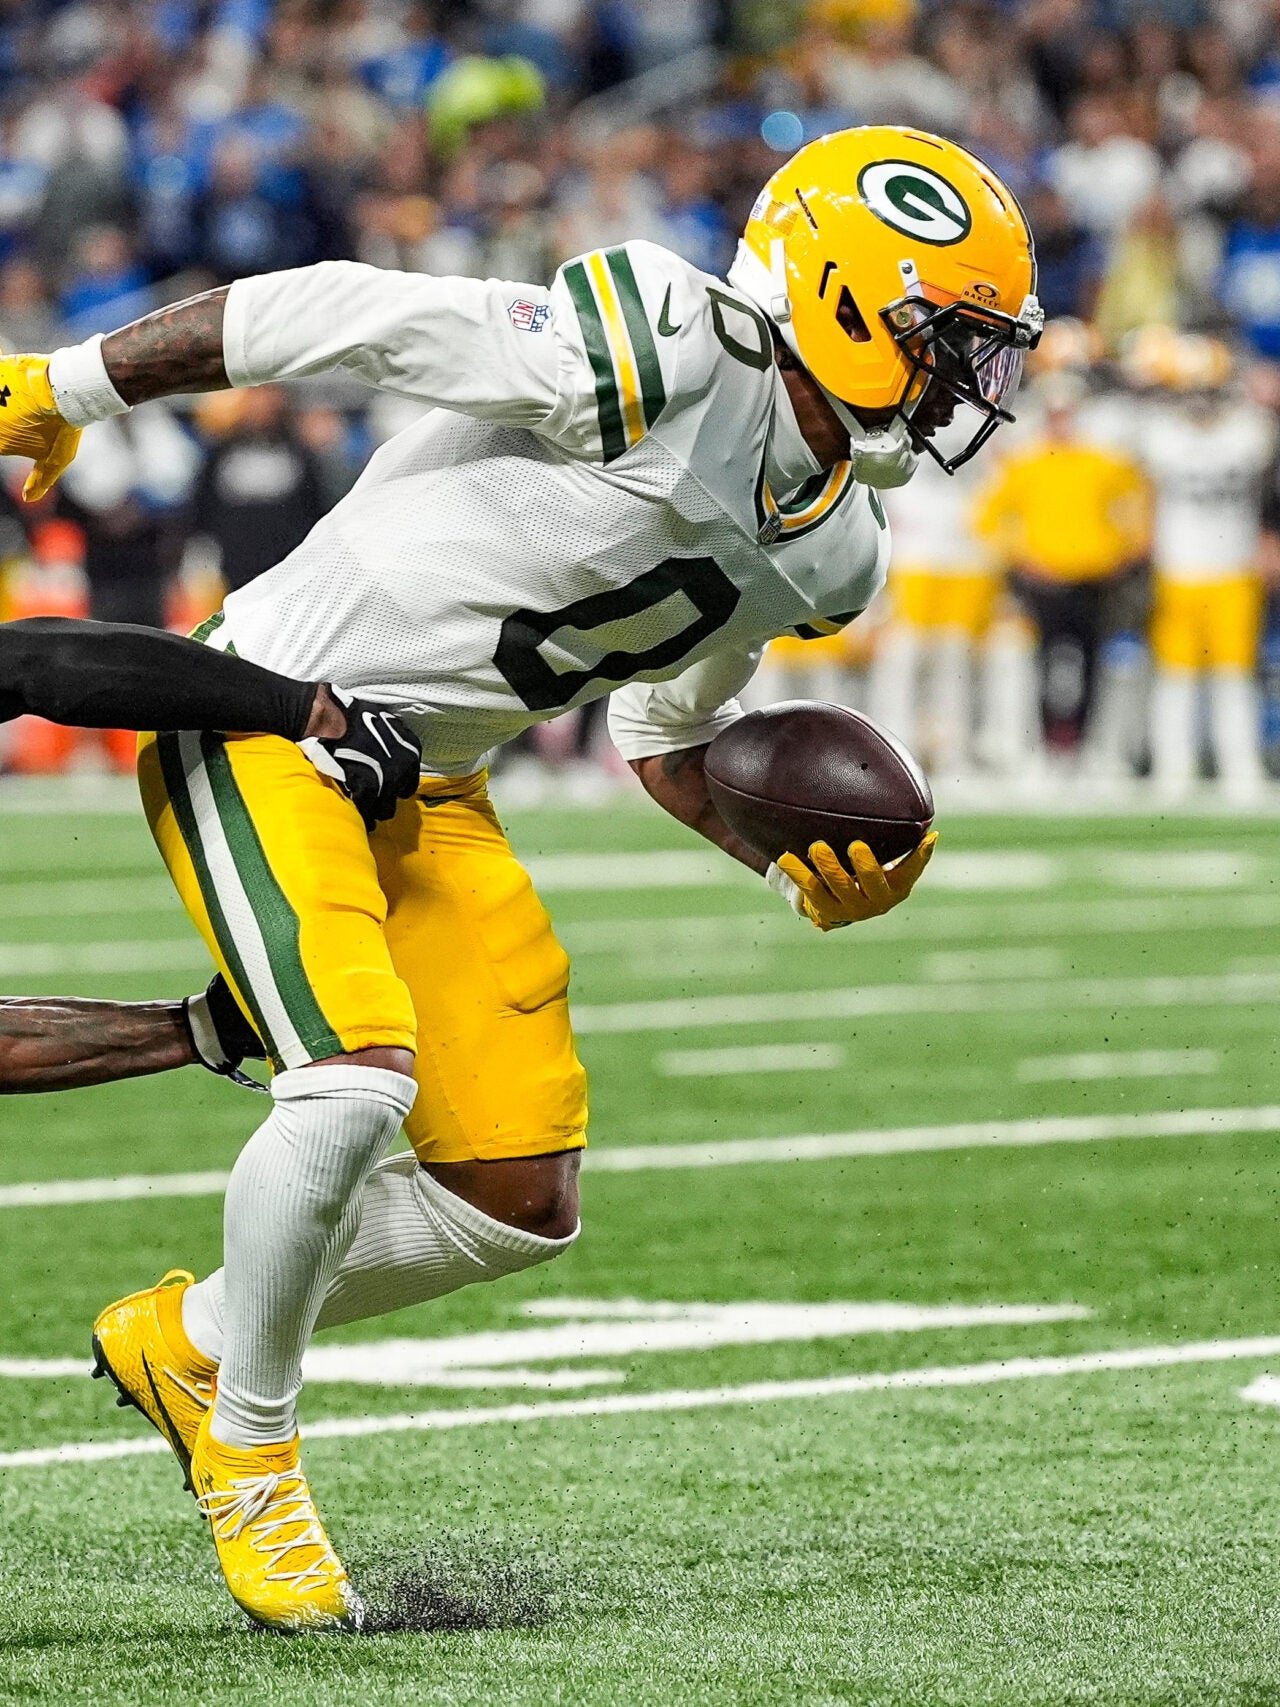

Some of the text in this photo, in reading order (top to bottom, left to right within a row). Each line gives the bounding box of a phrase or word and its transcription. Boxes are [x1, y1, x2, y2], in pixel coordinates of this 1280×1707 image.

[861, 162, 968, 242] G
[512, 302, 535, 326] NFL
[705, 286, 773, 373] 0
[964, 291, 999, 307] OAKLEY
[492, 556, 742, 711] 0
